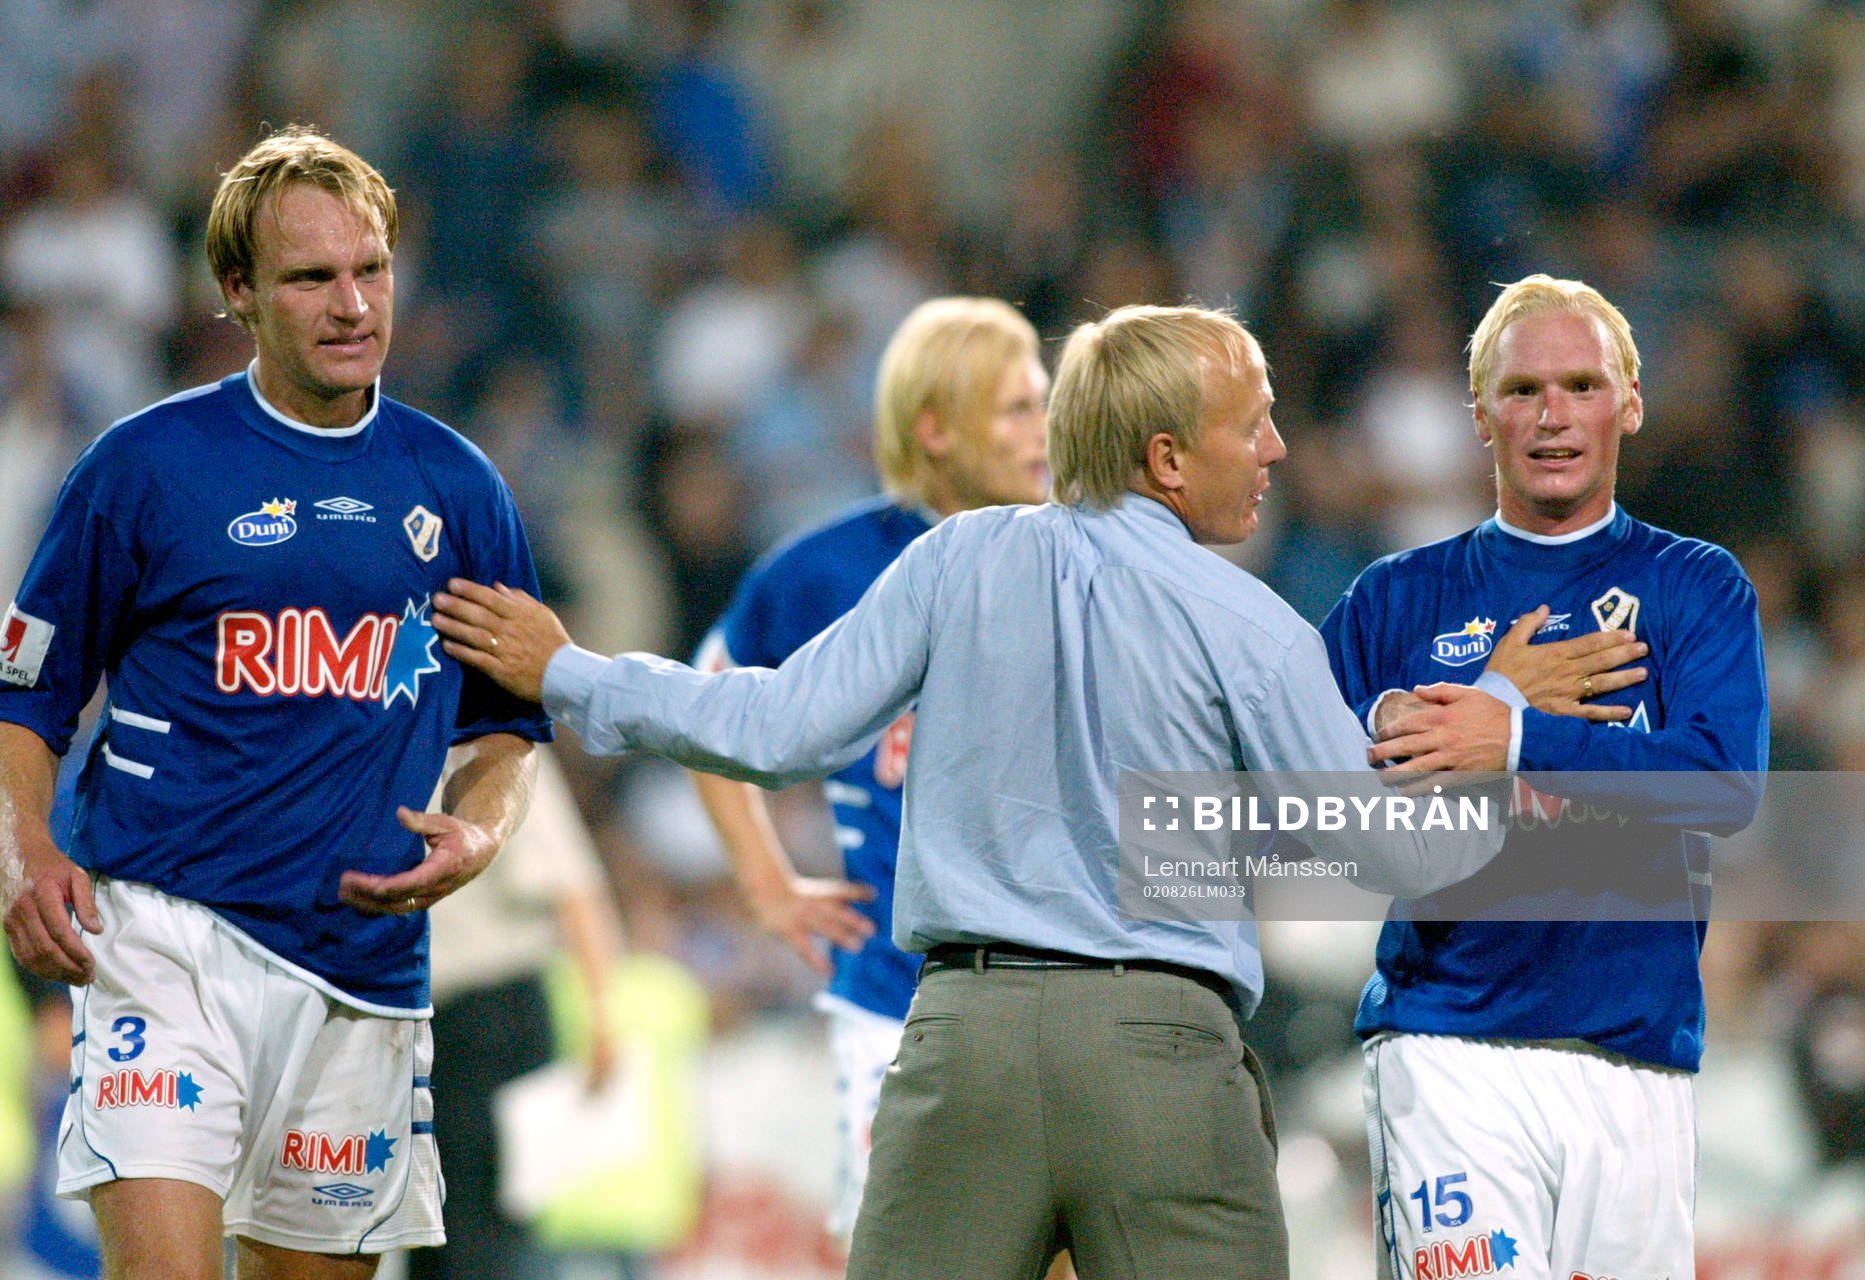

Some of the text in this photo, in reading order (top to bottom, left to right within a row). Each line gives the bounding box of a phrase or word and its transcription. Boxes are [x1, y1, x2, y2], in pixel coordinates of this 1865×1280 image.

[237, 518, 289, 538] Duni
[216, 607, 401, 702] RIMI
[1437, 637, 1485, 658] Duni
[6, 666, 30, 681] SPEL
[107, 1016, 146, 1062] 3
[95, 1069, 180, 1112] RIMI
[280, 1129, 367, 1175] RIMI
[1410, 1171, 1473, 1233] 15
[1412, 1234, 1494, 1280] RIMI
